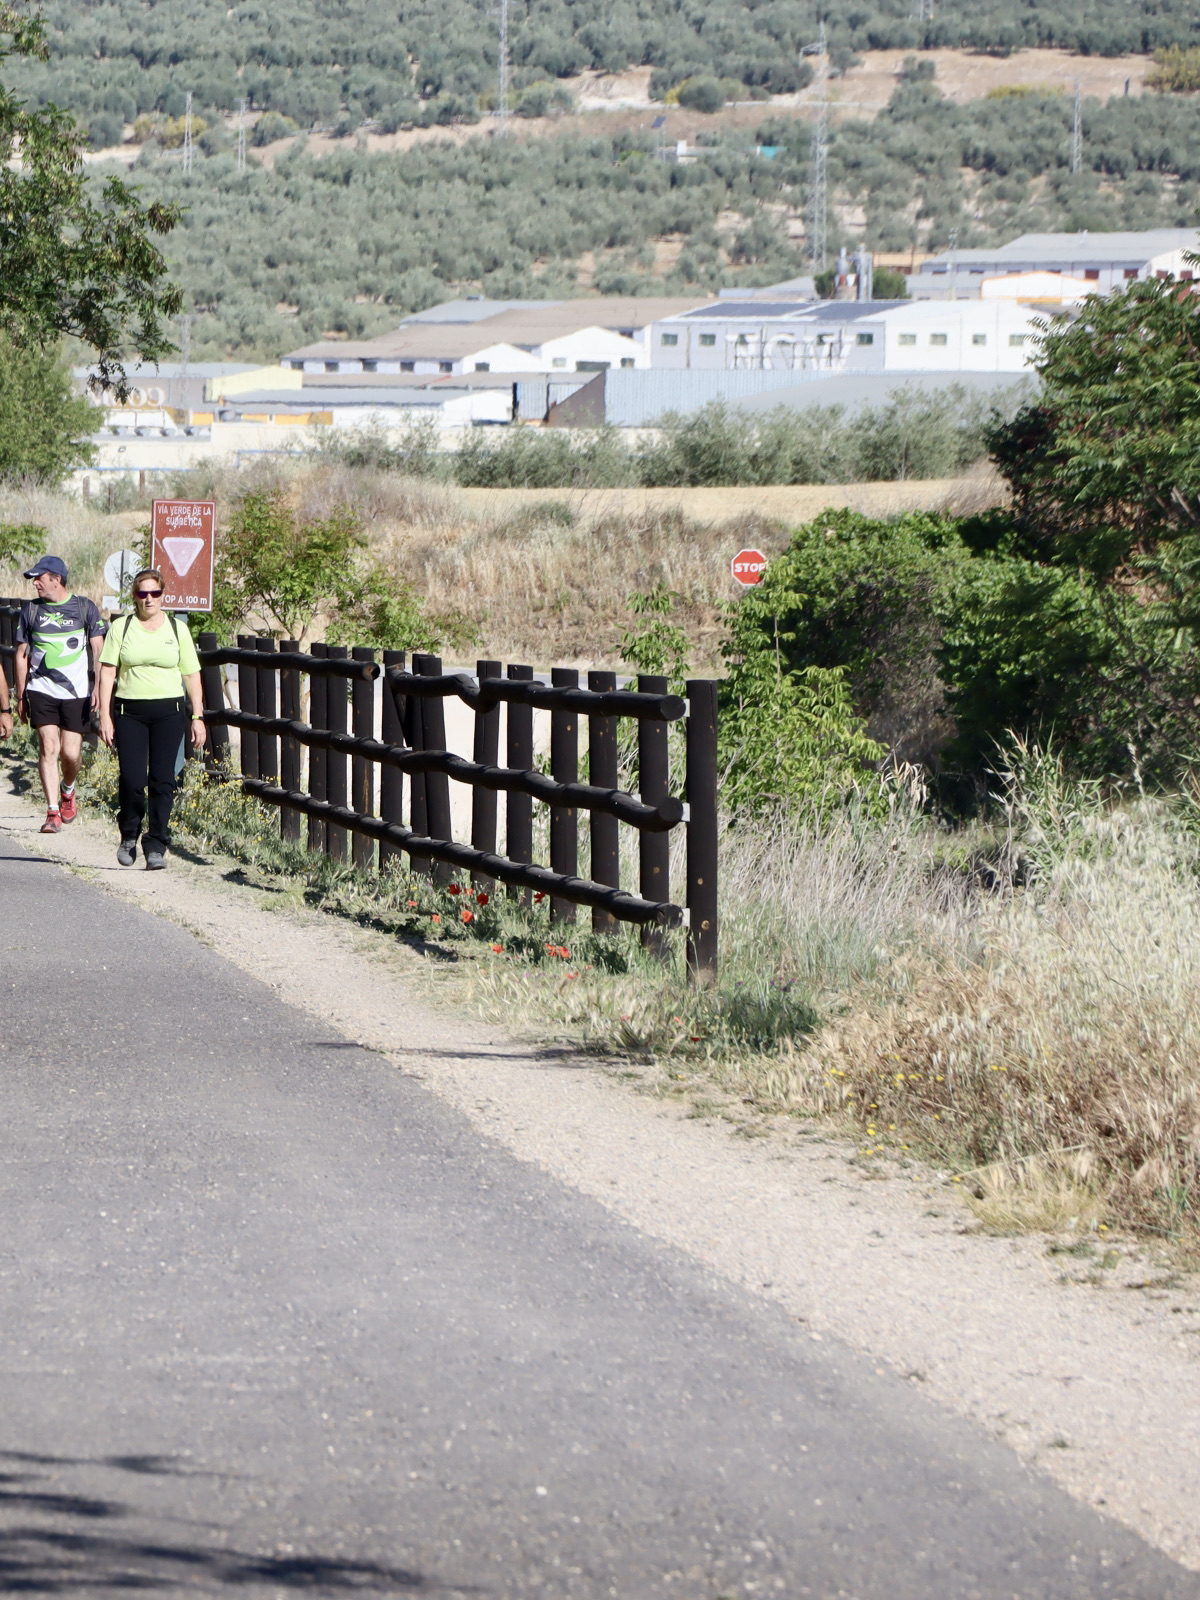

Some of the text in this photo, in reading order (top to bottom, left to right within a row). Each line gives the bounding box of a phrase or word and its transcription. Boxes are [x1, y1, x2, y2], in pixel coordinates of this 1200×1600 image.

[157, 504, 211, 516] VÍA VERDE DE LA
[735, 562, 765, 572] STOP
[161, 594, 176, 604] TOP
[177, 595, 183, 604] A
[185, 595, 198, 604] 100
